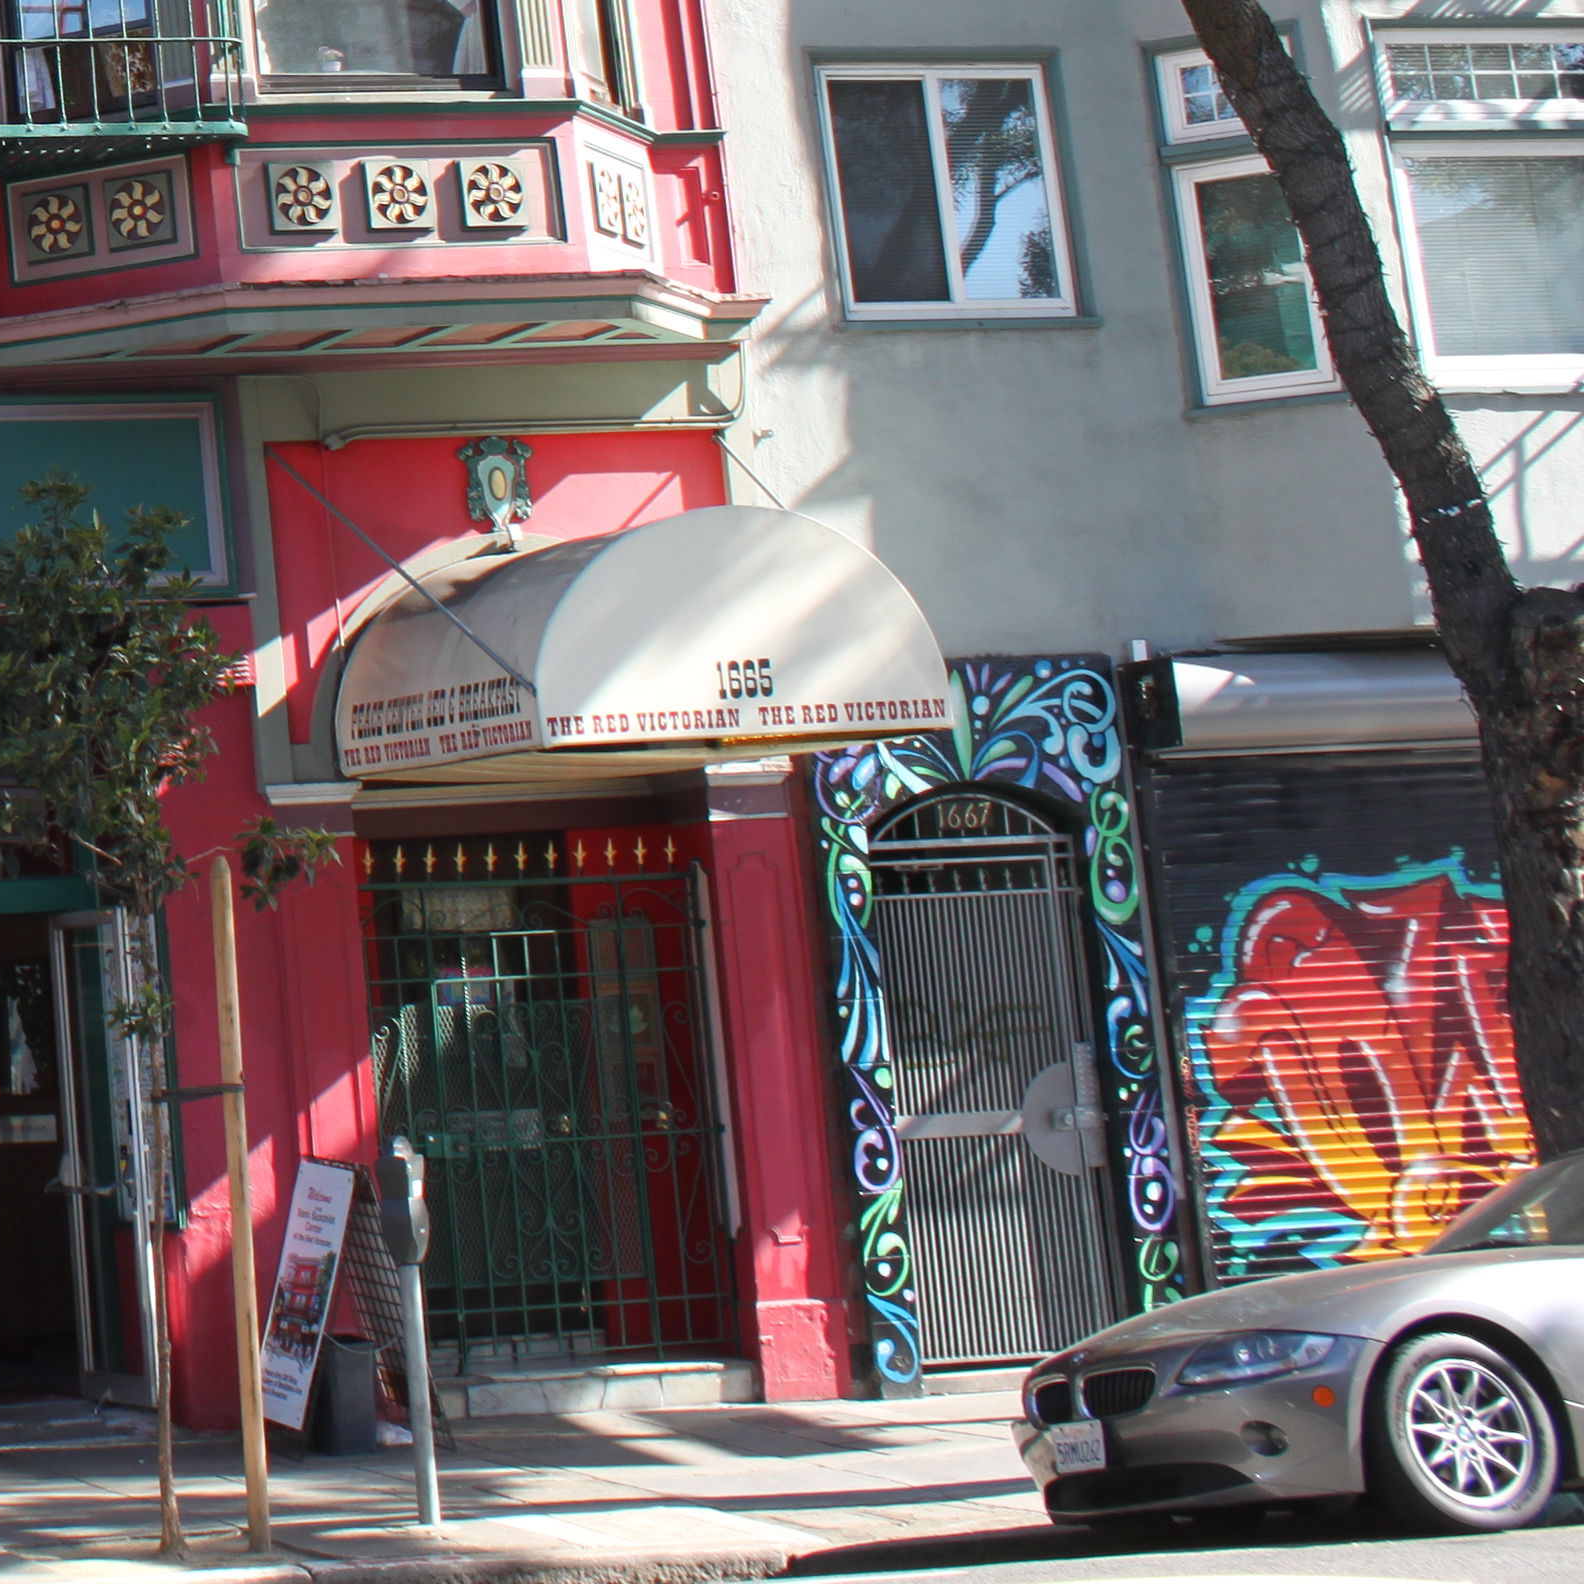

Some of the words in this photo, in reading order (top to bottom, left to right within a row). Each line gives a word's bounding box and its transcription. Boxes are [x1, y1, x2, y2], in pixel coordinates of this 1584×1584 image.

[716, 658, 773, 700] 1665
[351, 700, 384, 740] PEACE
[386, 693, 424, 734] CENTER
[427, 688, 446, 728] BED
[458, 676, 521, 722] BREAKFAST
[547, 716, 584, 737] THE
[593, 713, 630, 734] RED
[637, 708, 740, 733] VICTORIAN
[758, 705, 795, 726] THE
[801, 702, 838, 724] RED
[844, 698, 945, 722] VICTORIAN
[344, 748, 361, 767] THE
[364, 745, 381, 764] RED
[384, 737, 431, 762] VICTORIAN
[439, 733, 458, 754] THE
[461, 729, 480, 750] RED
[482, 720, 533, 748] VICTORIAN
[936, 801, 992, 829] 1667
